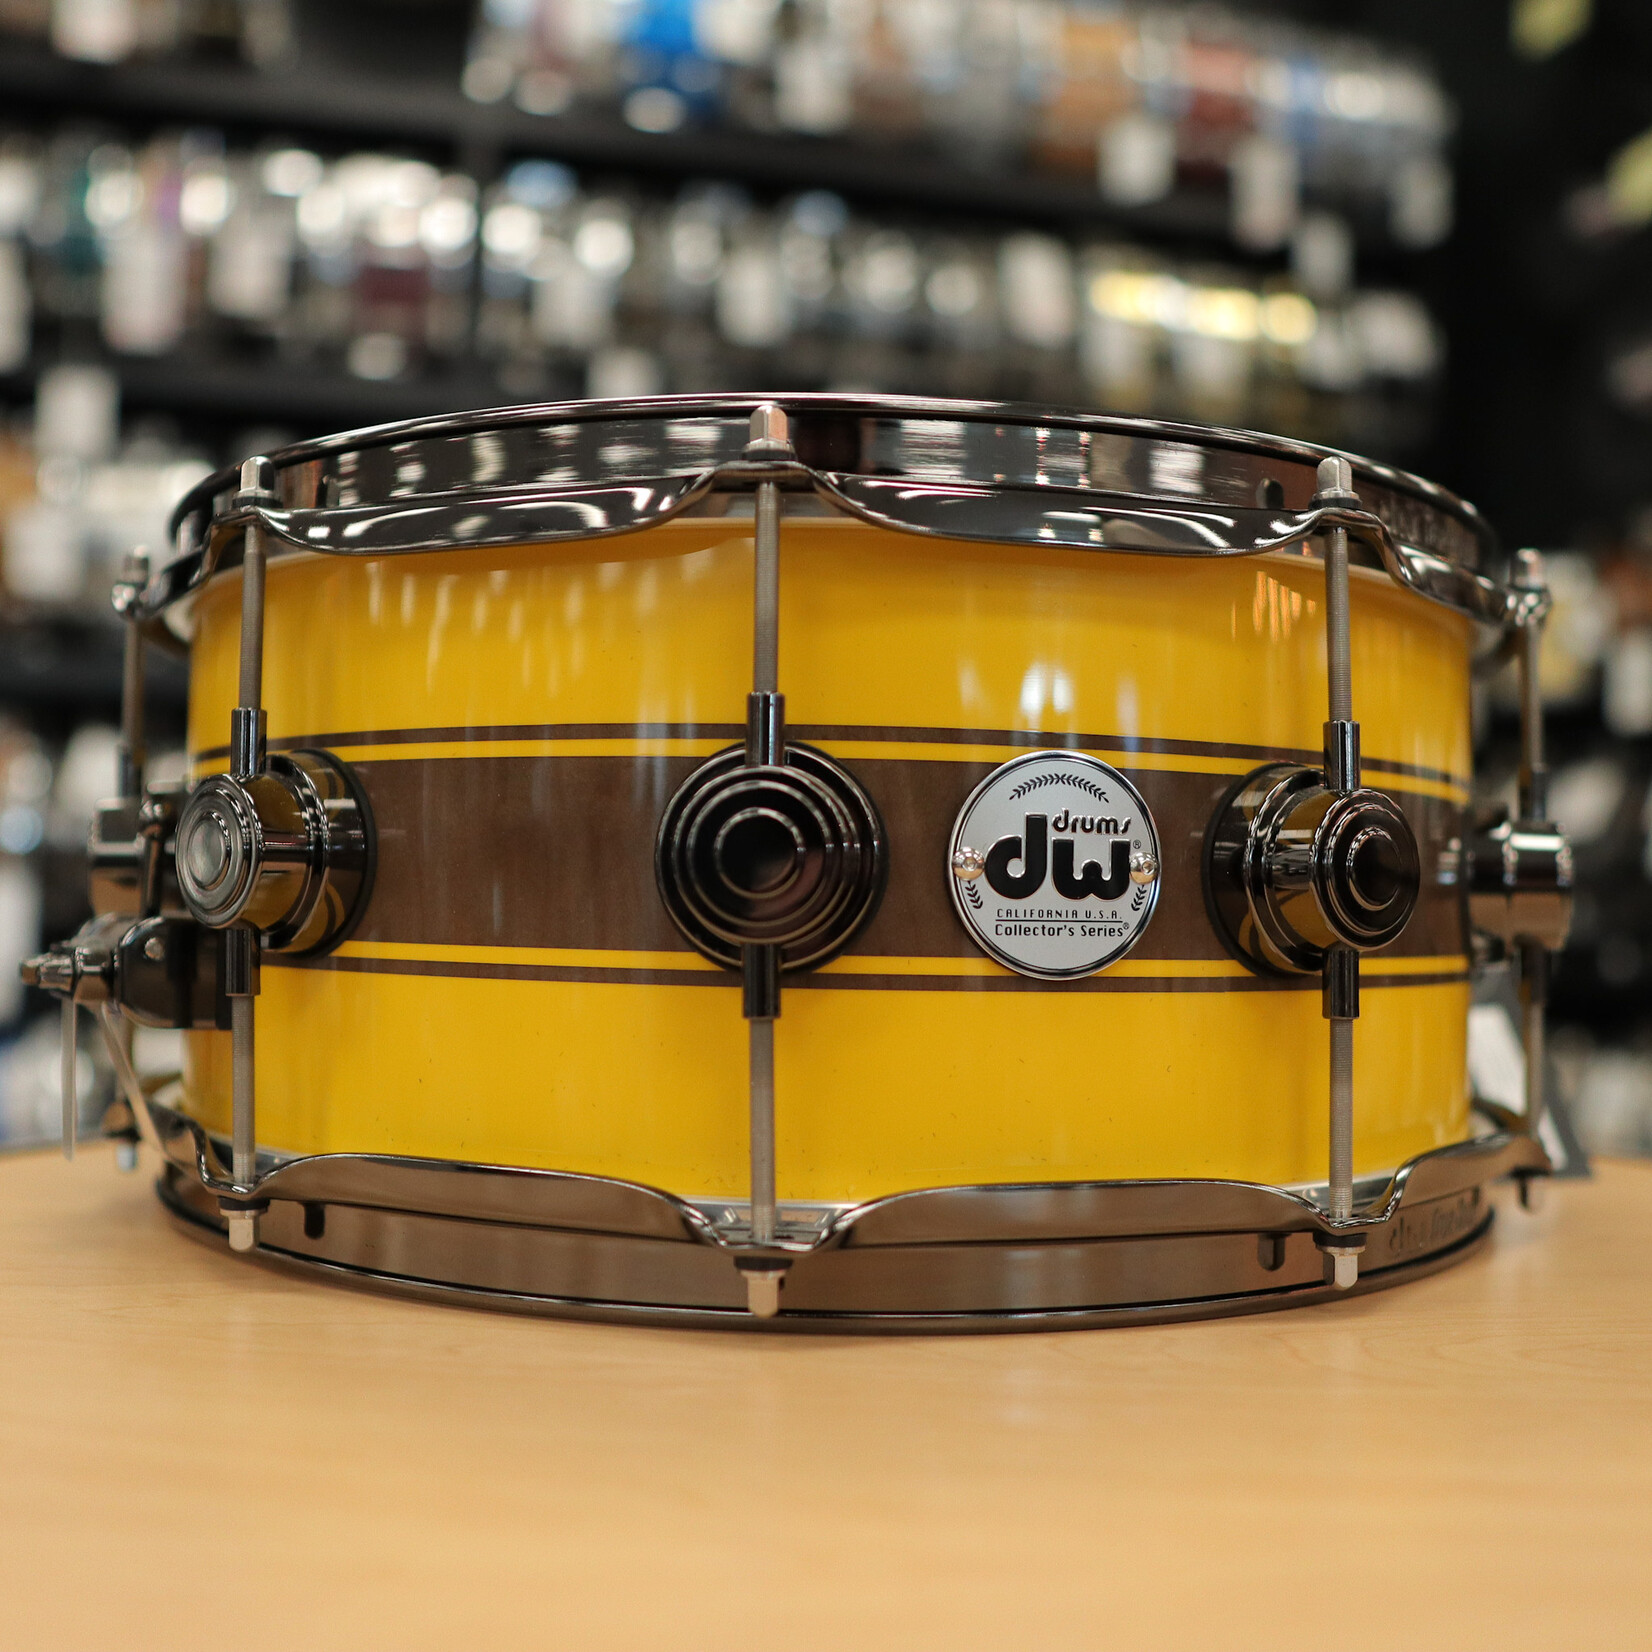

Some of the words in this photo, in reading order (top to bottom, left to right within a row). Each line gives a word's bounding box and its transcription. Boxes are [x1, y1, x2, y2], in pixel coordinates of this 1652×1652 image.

[1051, 807, 1132, 835] drums
[996, 908, 1078, 919] CALIFORNIA
[1085, 909, 1123, 919] U.S.A.
[995, 923, 1075, 937] Collector's
